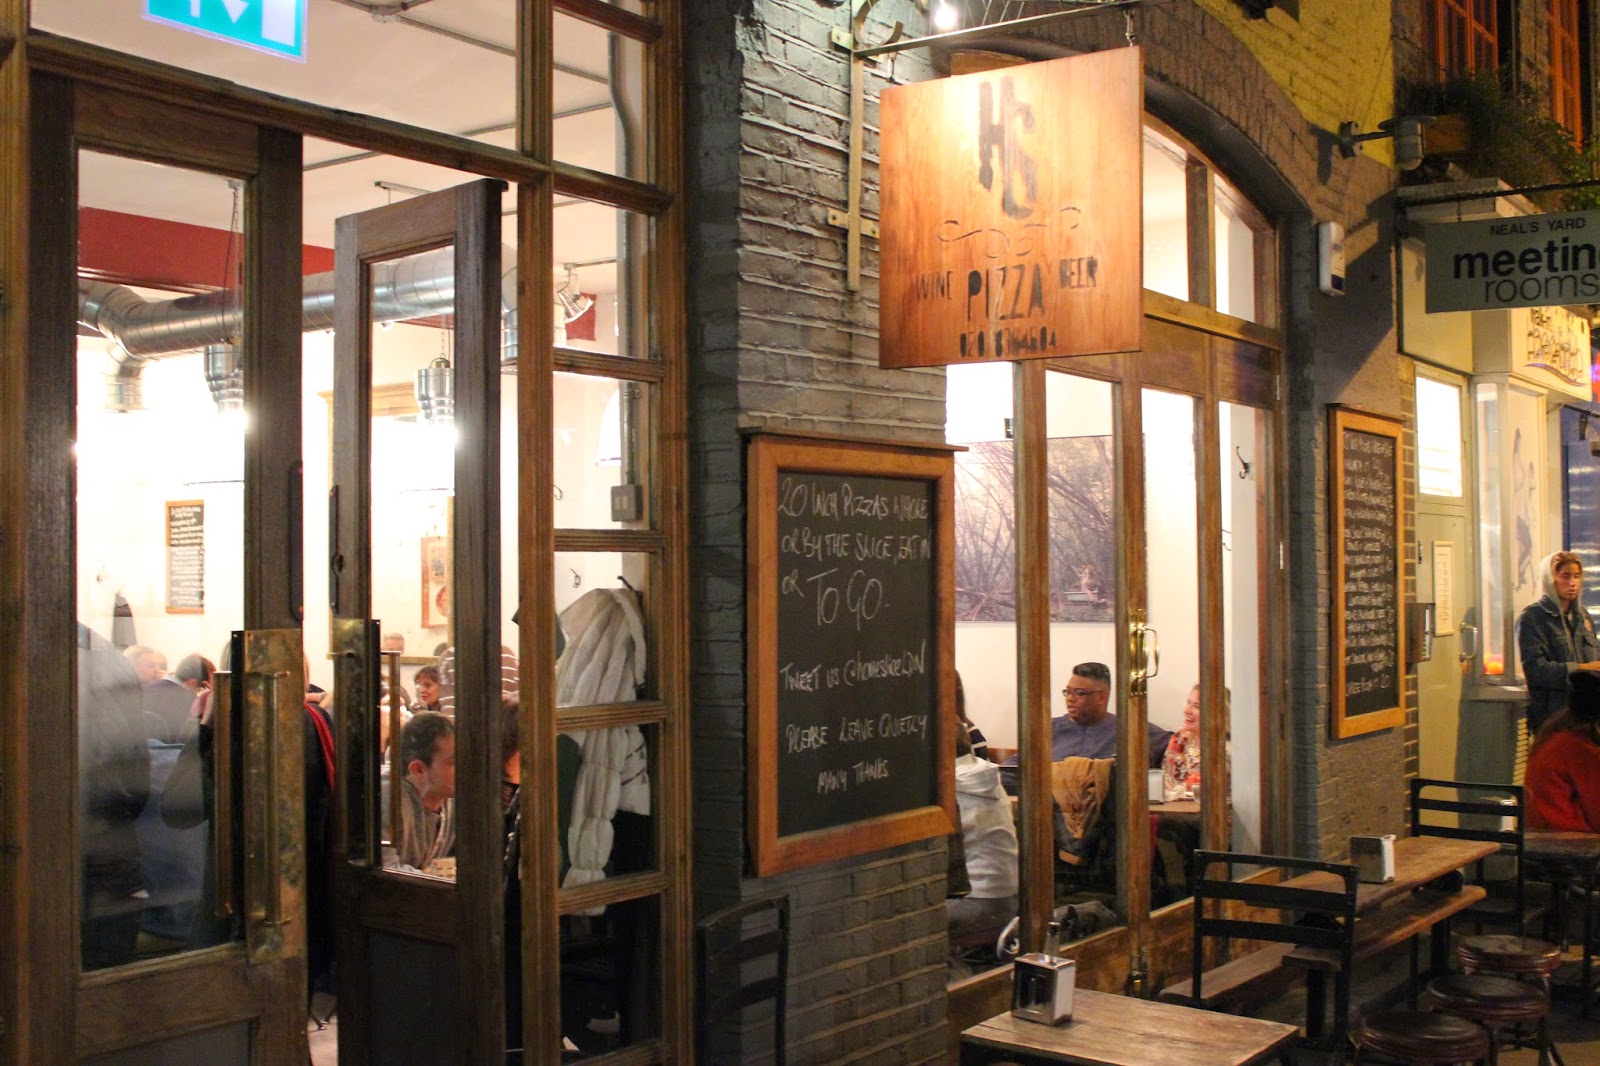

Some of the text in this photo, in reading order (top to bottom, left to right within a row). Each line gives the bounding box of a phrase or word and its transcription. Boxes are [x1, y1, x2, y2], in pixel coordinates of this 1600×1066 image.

[1491, 217, 1586, 236] NEAL'S YARD
[1453, 236, 1600, 279] meetin
[915, 269, 953, 300] WINE
[967, 263, 1045, 322] PIZZA
[1484, 273, 1600, 303] rooms
[778, 477, 808, 517] 20
[842, 483, 889, 520] PIZZAS
[802, 527, 822, 562] BY
[825, 533, 850, 558] THE
[781, 569, 805, 598] OR
[806, 568, 840, 626] TO
[780, 662, 822, 692] TWEET
[786, 724, 829, 754] PLEASE
[839, 717, 874, 742] LEAVE
[817, 769, 848, 795] MANY
